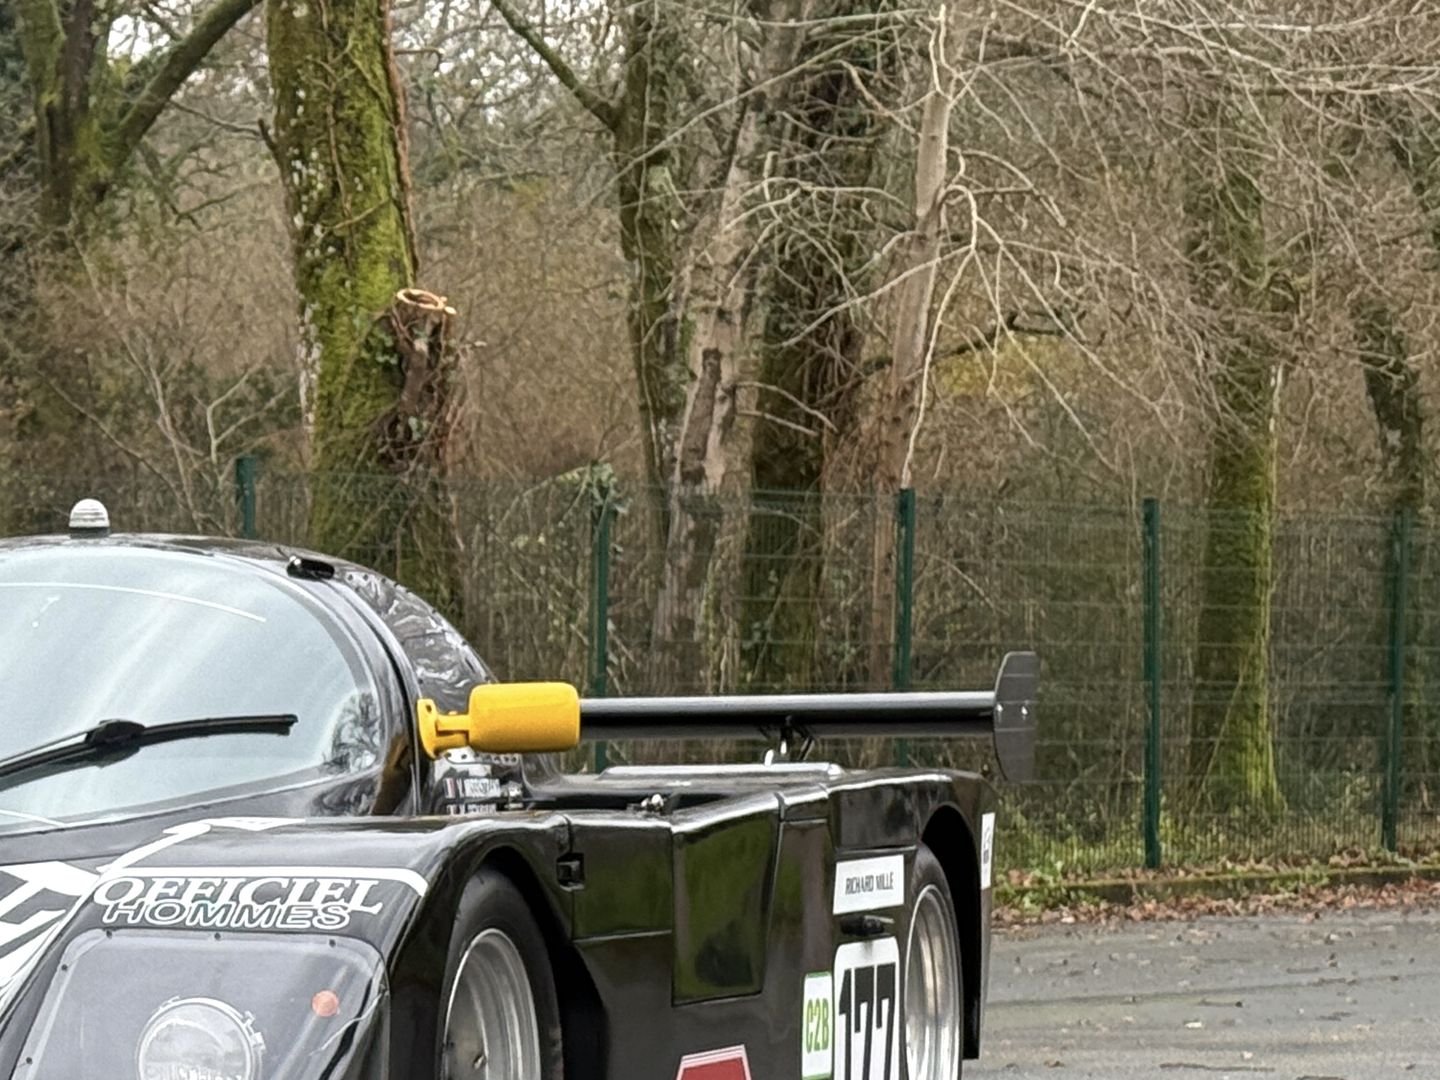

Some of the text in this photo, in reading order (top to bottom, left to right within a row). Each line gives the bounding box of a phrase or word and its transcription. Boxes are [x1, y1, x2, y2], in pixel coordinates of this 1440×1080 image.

[93, 877, 384, 914] OFFICIEL
[845, 874, 875, 895] RICHARD
[102, 897, 351, 929] HOMMES
[806, 998, 829, 1054] C2B
